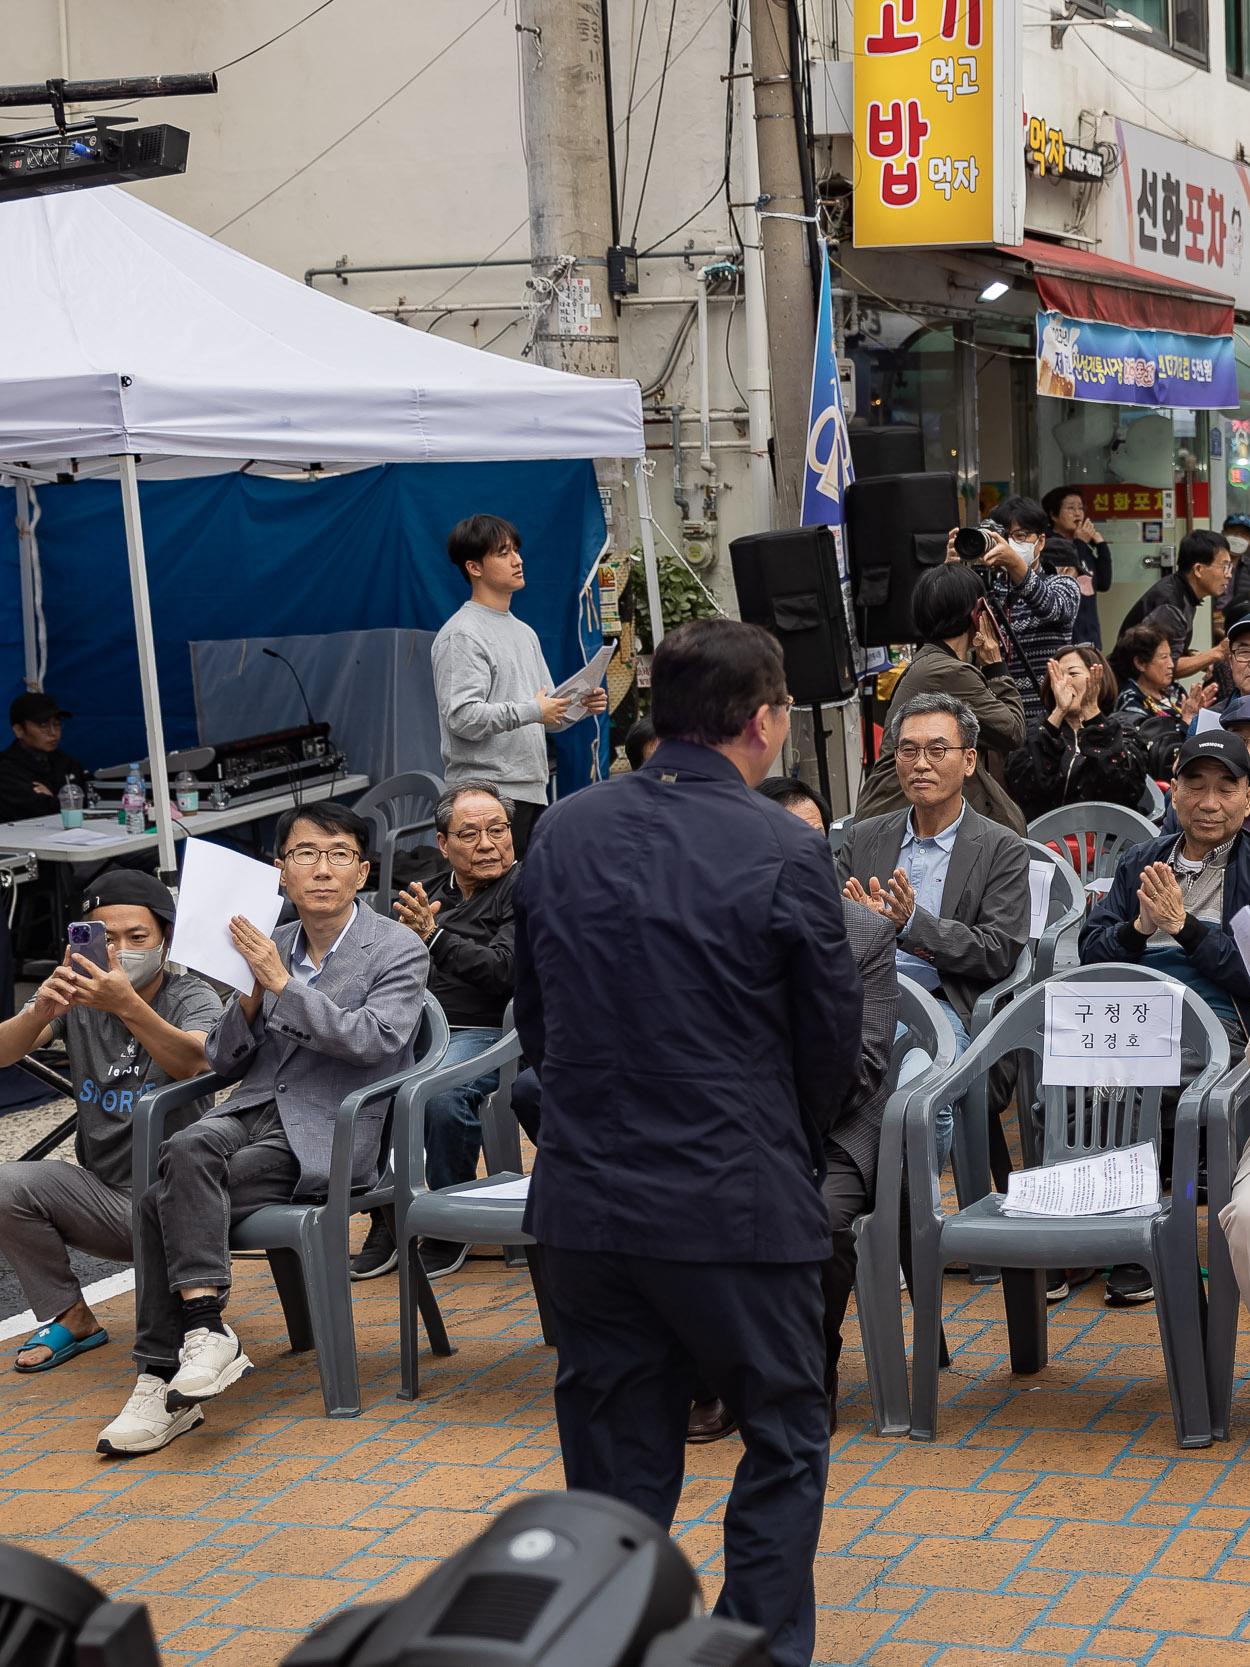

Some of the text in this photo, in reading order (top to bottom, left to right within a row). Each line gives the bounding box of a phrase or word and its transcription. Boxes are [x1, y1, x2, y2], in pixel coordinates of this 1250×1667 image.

[930, 56, 979, 103] 먹고
[866, 98, 931, 209] 밥
[928, 155, 979, 201] 먹자
[1029, 116, 1065, 178] 먹자
[1136, 167, 1228, 269] 선화포차
